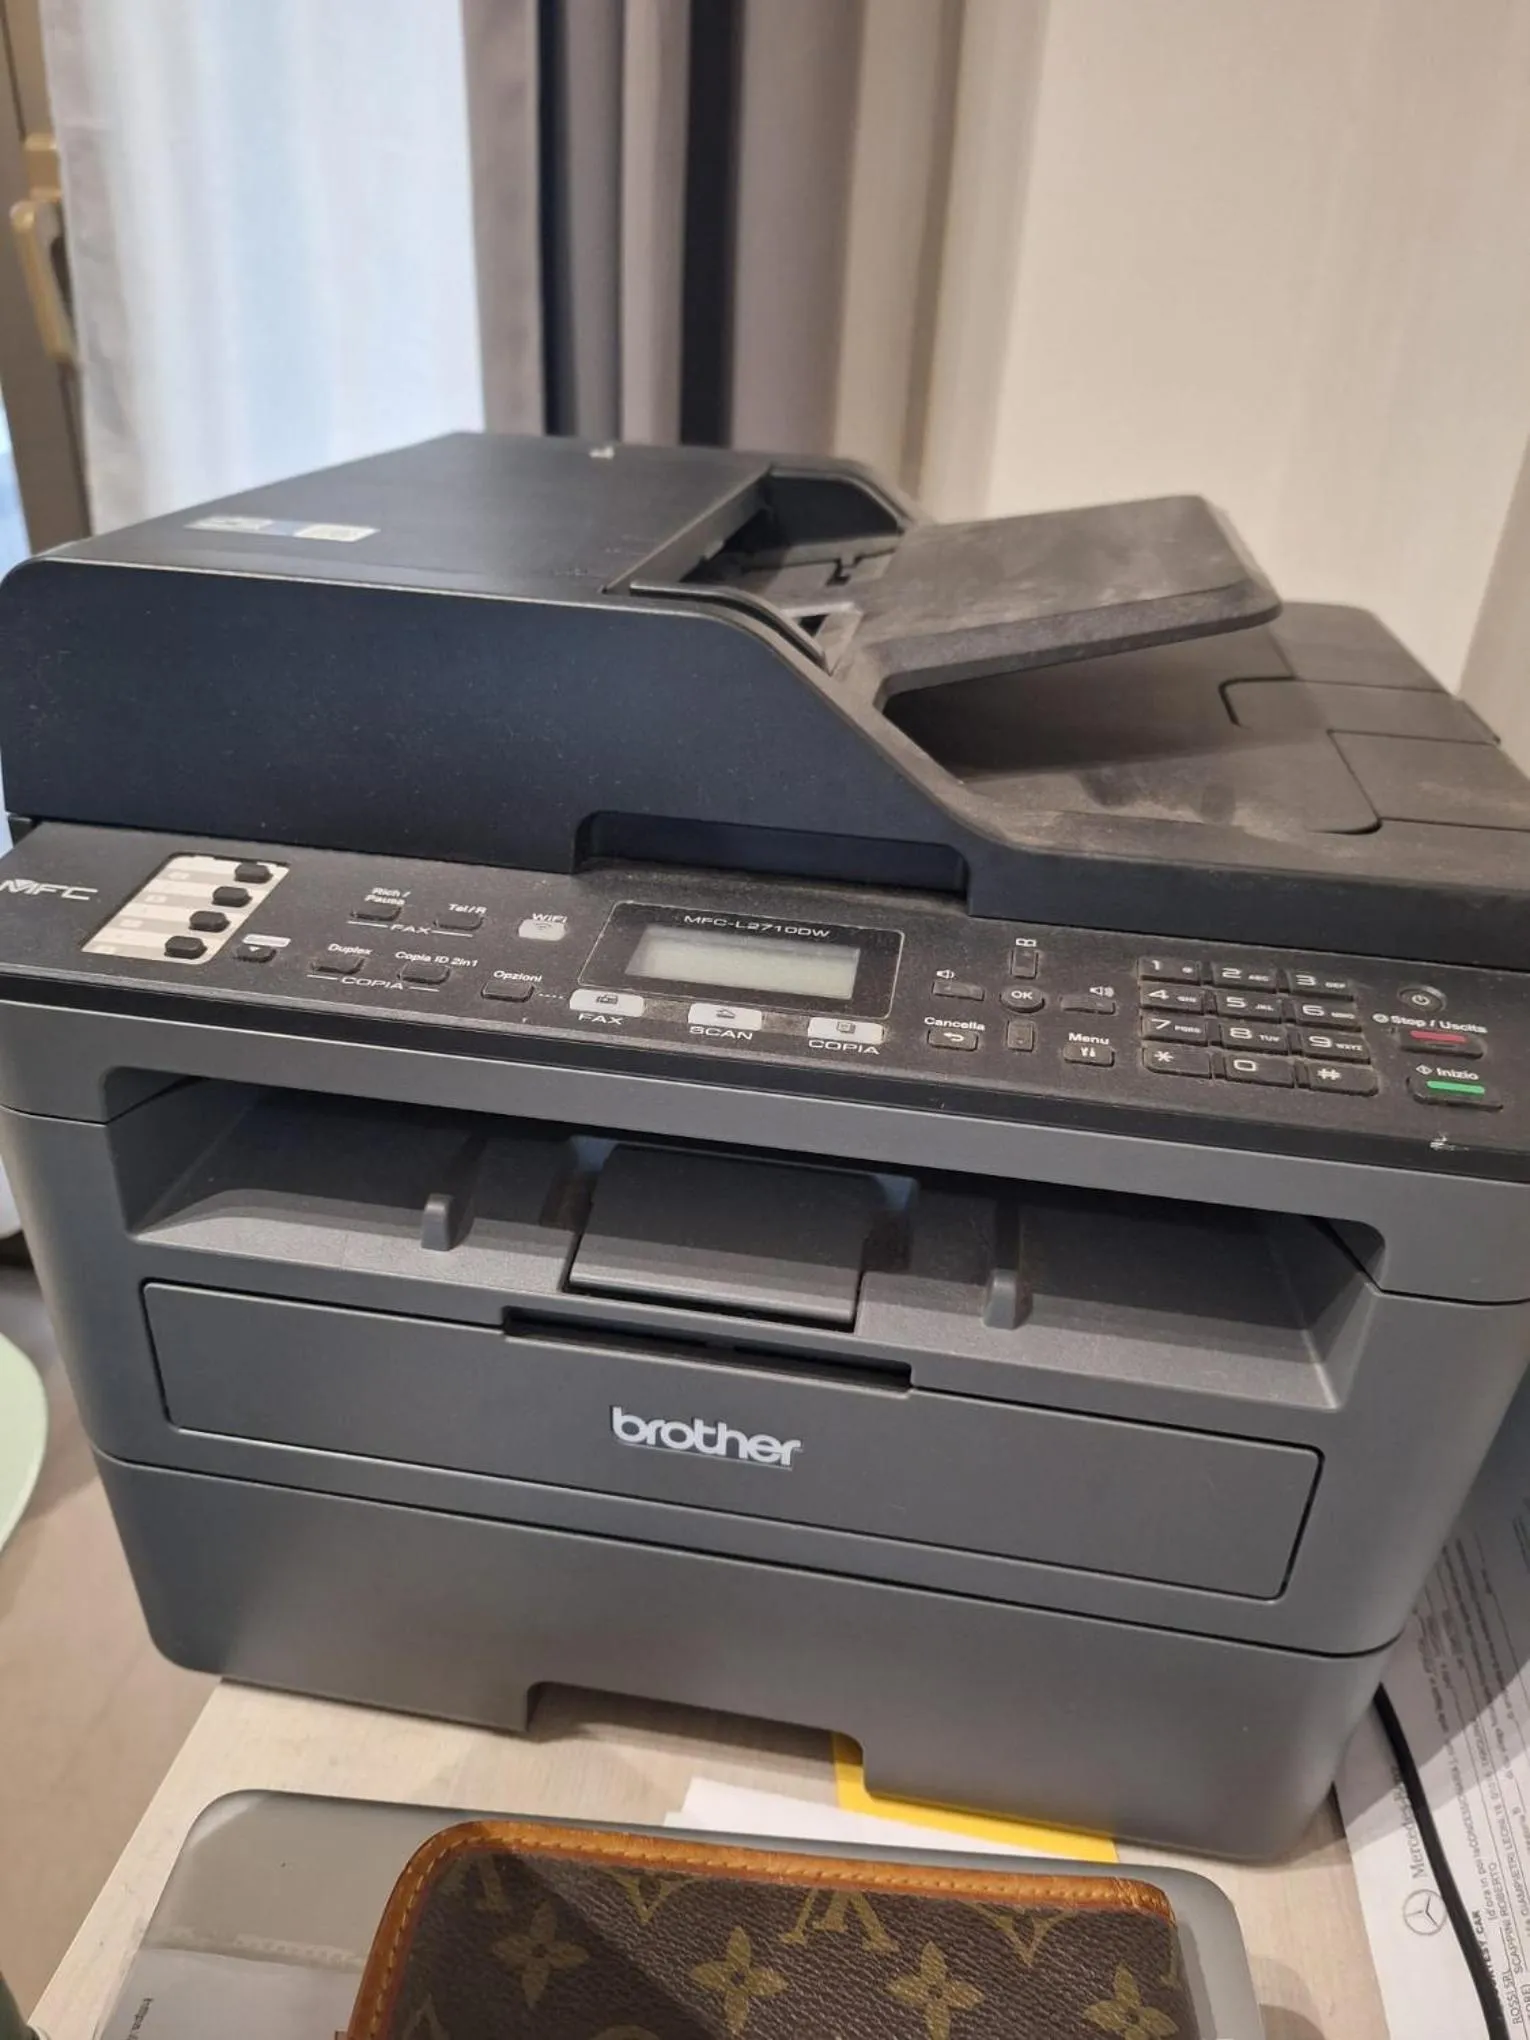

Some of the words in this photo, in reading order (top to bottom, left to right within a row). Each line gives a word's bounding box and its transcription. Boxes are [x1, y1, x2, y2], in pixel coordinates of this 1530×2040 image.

[0, 879, 98, 900] MFC
[448, 903, 487, 914] Tel/R
[532, 913, 567, 923] WiFi
[390, 923, 431, 935] FAX
[684, 915, 830, 937] MFC-L2710DW
[328, 943, 373, 955] Duplex
[395, 951, 431, 962] Copia
[451, 957, 478, 967] 2in1
[493, 970, 542, 982] Opzioni
[1222, 967, 1242, 979] 2
[341, 977, 403, 990] COPIA
[1295, 974, 1317, 986] 3
[1011, 990, 1033, 1000] OK
[1148, 989, 1169, 1000] 4
[1226, 996, 1247, 1008] 5
[1302, 1004, 1325, 1016] 6
[578, 1013, 623, 1025] FAX
[924, 1016, 985, 1031] Cancella
[1151, 1018, 1171, 1030] 7
[1390, 1015, 1427, 1027] Stop
[1438, 1020, 1488, 1033] Uscita
[689, 1026, 753, 1041] SCAN
[1068, 1032, 1109, 1045] Menu
[1230, 1027, 1253, 1039] 8
[808, 1039, 880, 1055] COPIA
[1309, 1035, 1332, 1048] 9
[1234, 1059, 1257, 1071] 0
[1436, 1067, 1479, 1080] Inizio
[612, 1406, 801, 1466] brother
